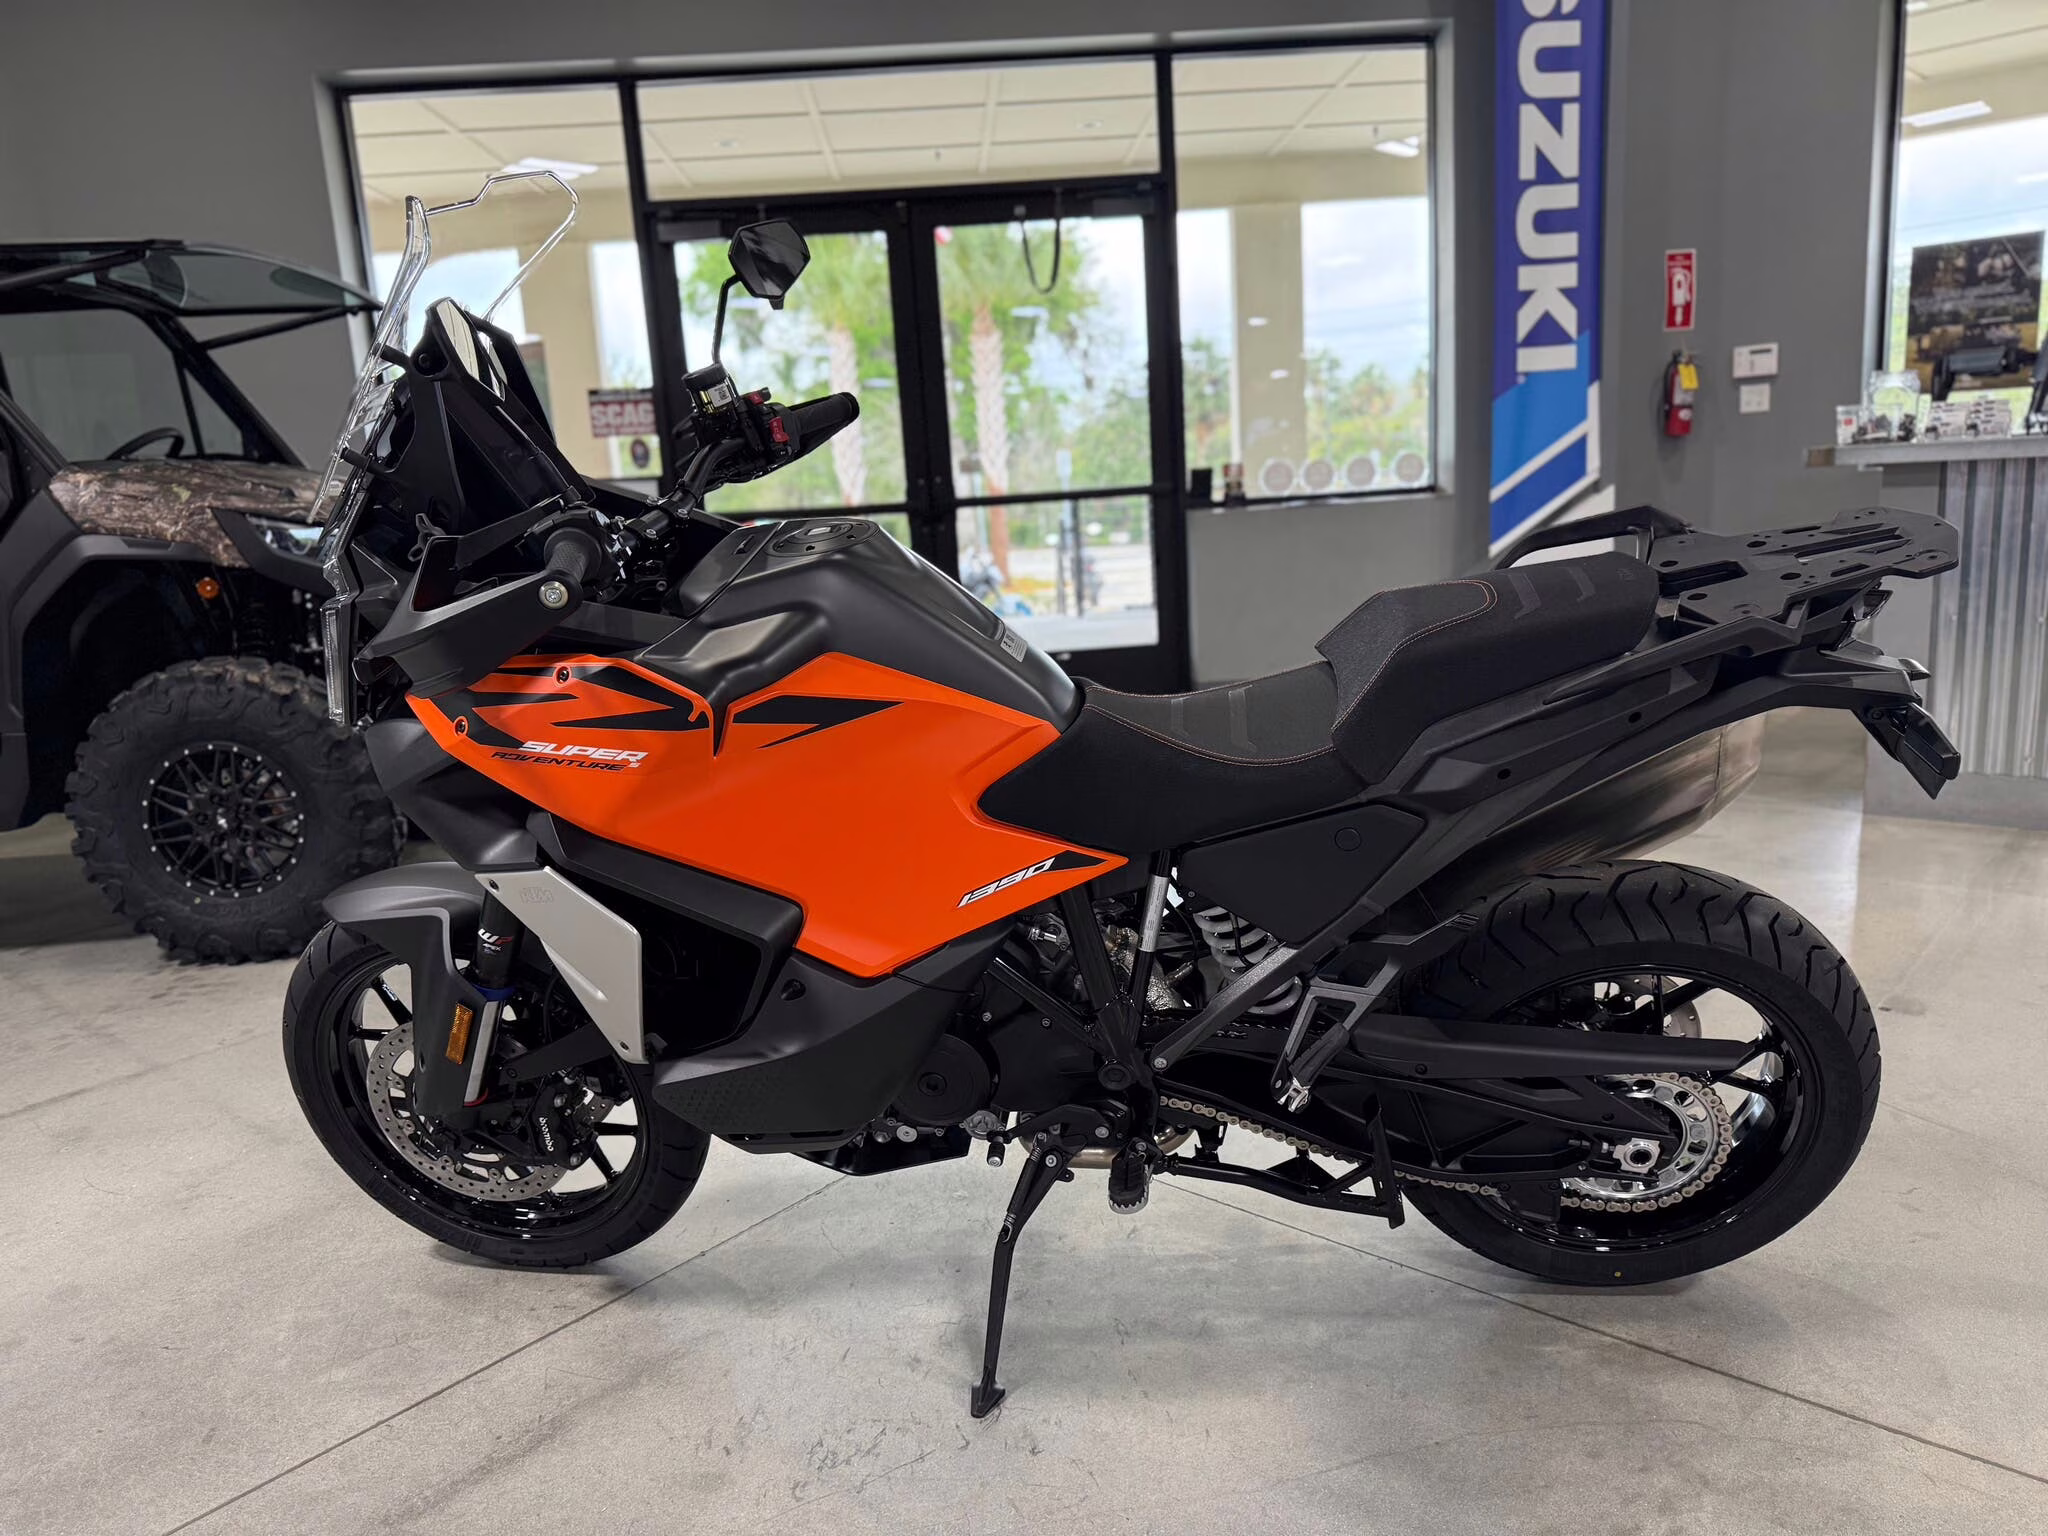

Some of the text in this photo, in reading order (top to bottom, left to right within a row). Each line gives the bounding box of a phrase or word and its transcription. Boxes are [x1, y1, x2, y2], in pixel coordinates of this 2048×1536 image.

[1515, 0, 1582, 374] UZUKI
[591, 402, 654, 426] SCAG
[491, 751, 627, 771] ADVENTURE
[518, 740, 648, 761] SUPER
[957, 857, 1056, 908] 1390
[478, 928, 514, 945] WP
[539, 1116, 555, 1152] brembo
